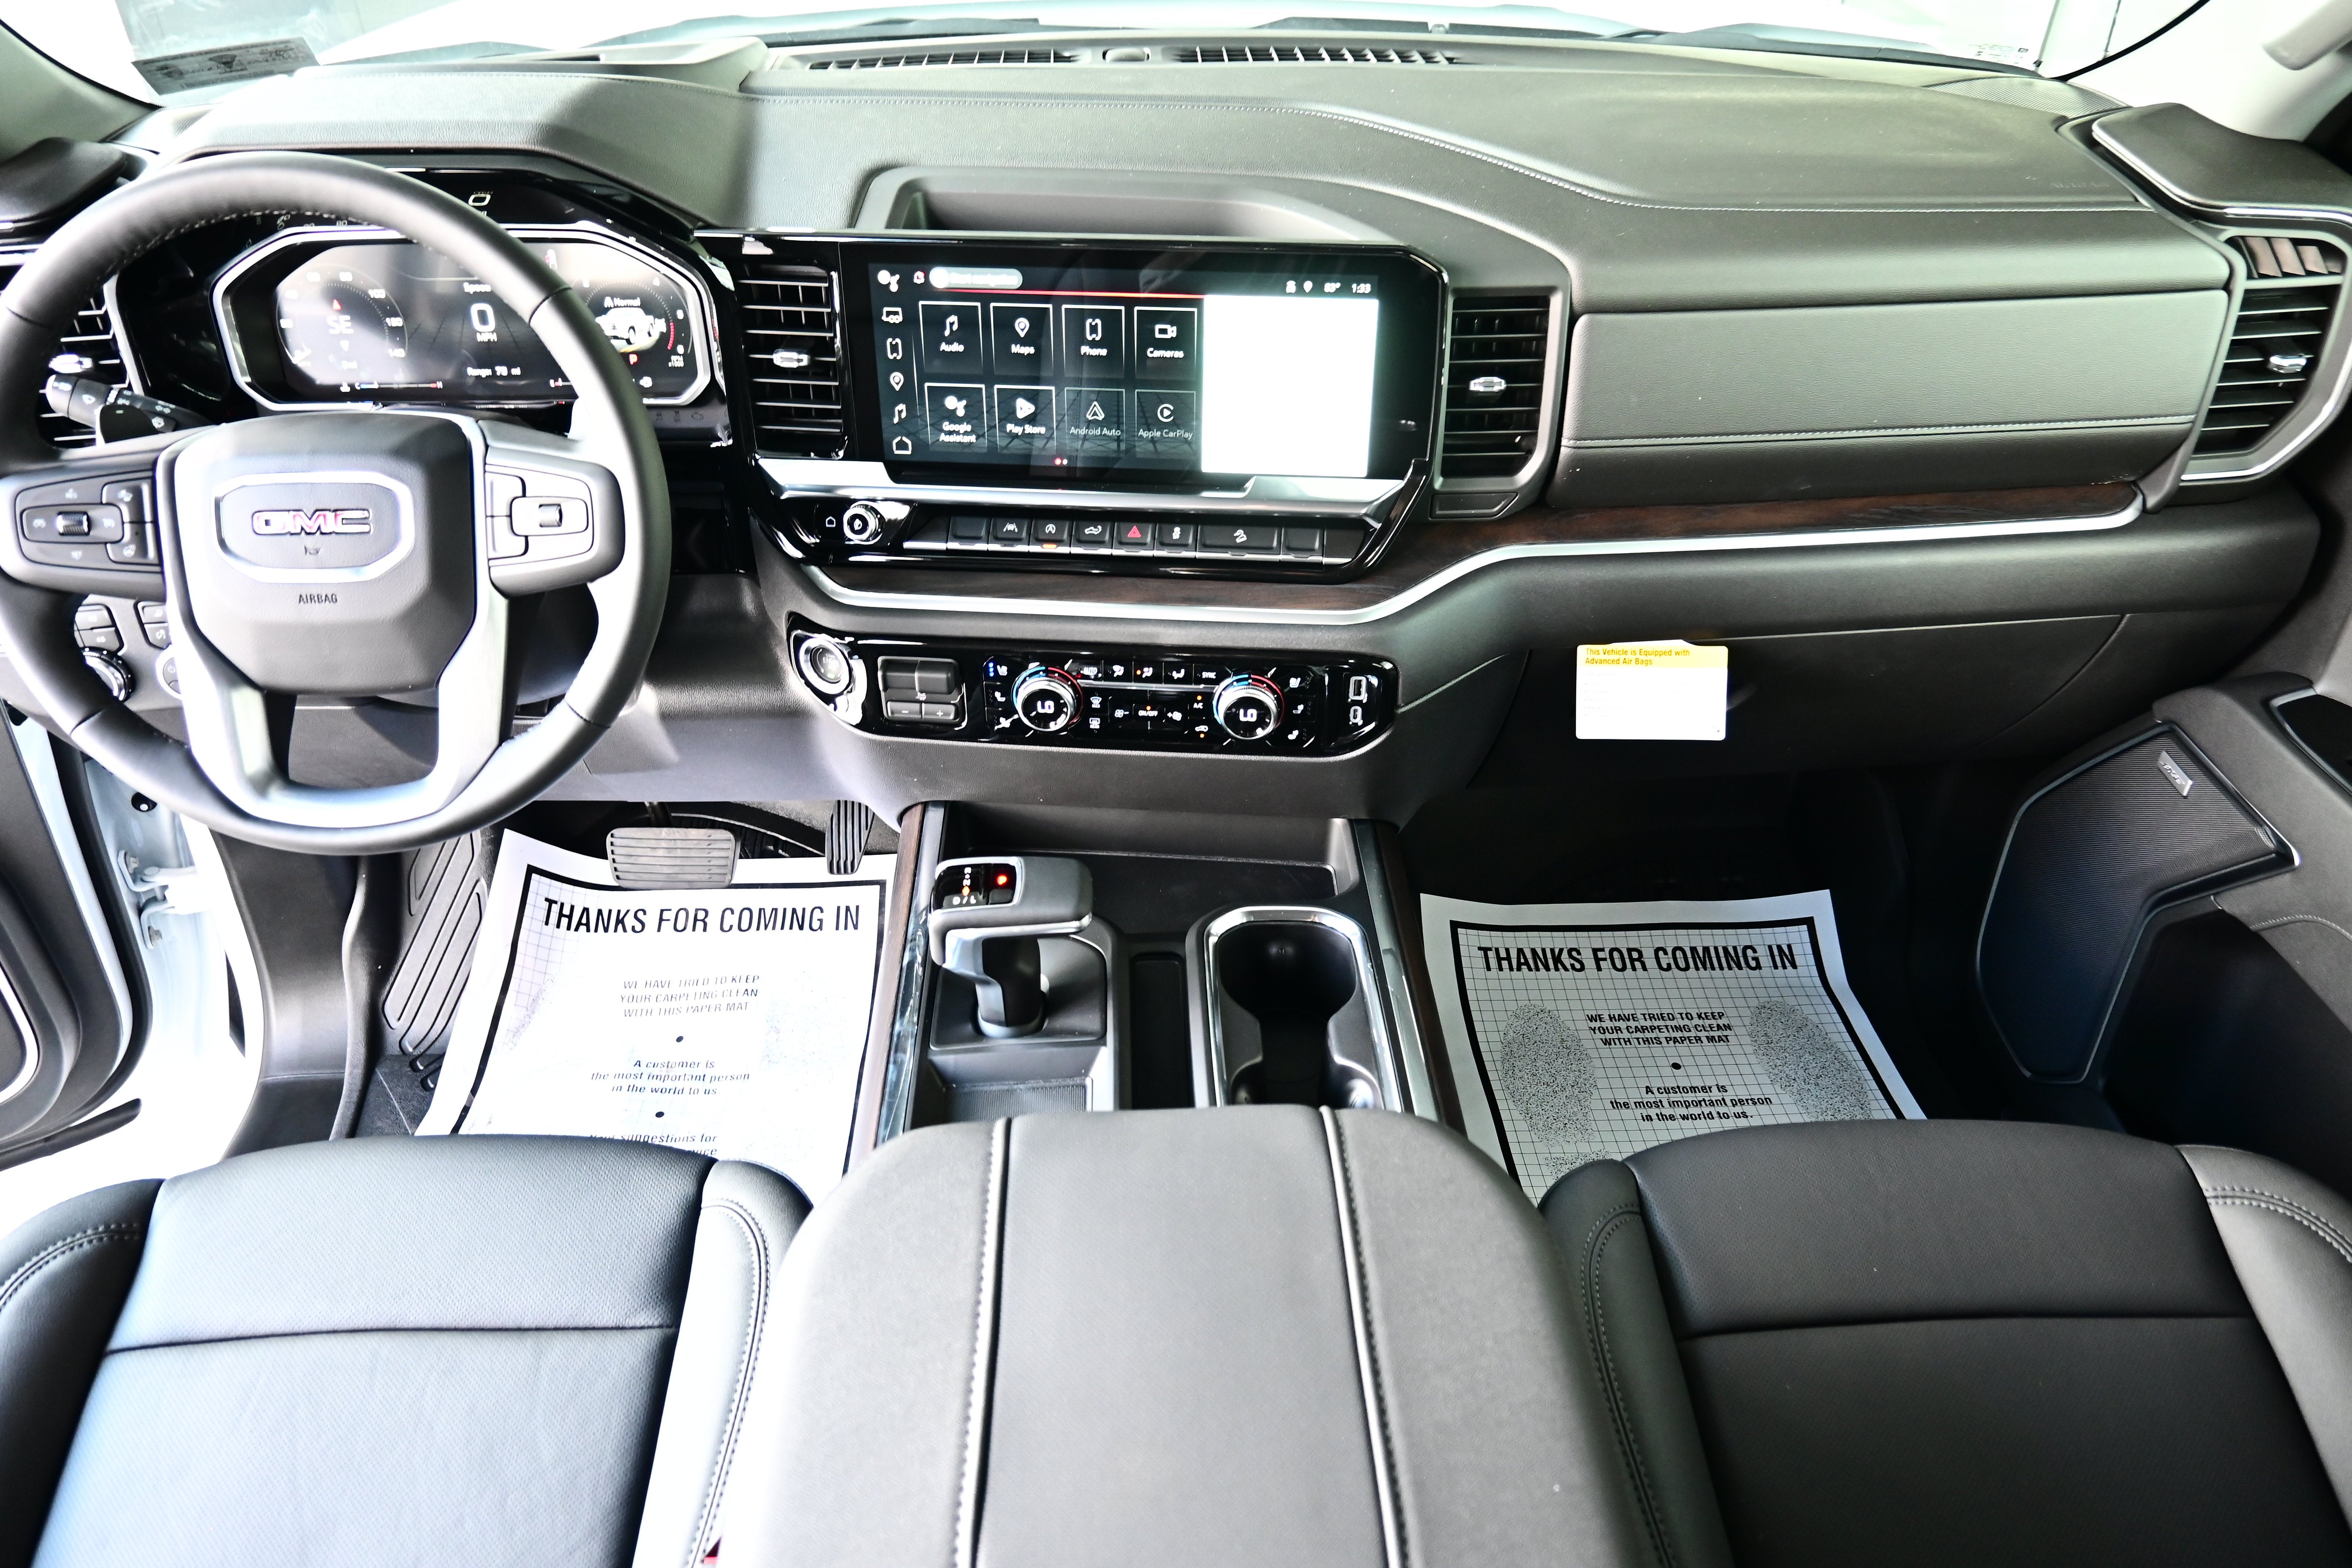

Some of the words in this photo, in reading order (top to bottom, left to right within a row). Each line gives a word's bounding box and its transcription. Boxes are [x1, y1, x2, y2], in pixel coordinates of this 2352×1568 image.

[471, 303, 495, 332] 0
[327, 316, 354, 335] SE
[476, 332, 497, 342] MPH
[940, 343, 964, 352] Audio
[1011, 344, 1035, 356] Maps
[1081, 346, 1107, 356] Phone
[1147, 348, 1184, 359] Cameras
[629, 354, 637, 365] P
[942, 422, 972, 433] Google
[1007, 424, 1023, 435] Play
[1024, 425, 1045, 435] Store
[1070, 427, 1103, 436] Android
[1104, 427, 1121, 436] Auto
[939, 433, 976, 444] Assistant
[1138, 428, 1161, 438] Apple
[1162, 430, 1193, 440] CarPlay
[252, 509, 371, 535] GMC
[299, 594, 338, 604] AIRBAG
[1639, 649, 1672, 657] Equipped
[1635, 658, 1653, 666] Bags
[544, 898, 646, 933] THANKS
[657, 907, 709, 932] FOR
[720, 906, 824, 932] COMING
[835, 905, 860, 931] IN
[1478, 947, 1585, 972] THANKS
[1592, 947, 1647, 972] FOR
[1654, 945, 1762, 972] COMING
[1768, 944, 1799, 971] IN
[645, 980, 672, 988] HAVE
[715, 976, 727, 985] TO
[732, 975, 759, 983] KEEP
[621, 994, 651, 1003] YOUR
[656, 991, 718, 1002] CARPETING
[722, 989, 758, 997] CLEAN
[624, 1008, 653, 1017] WITH
[659, 1007, 682, 1016] THIS
[686, 1004, 721, 1013] PAPER
[726, 1002, 749, 1011] MAT
[1587, 1014, 1606, 1023] WE
[1608, 1013, 1639, 1022] HAVE
[1641, 1013, 1675, 1021] TRIED
[1677, 1012, 1694, 1021] TO
[1696, 1012, 1725, 1020] KEEP
[1589, 1026, 1623, 1034] YOUR
[1626, 1024, 1692, 1034] CARPETING
[1694, 1023, 1732, 1032] CLEAN
[1600, 1037, 1632, 1046] WITH
[1633, 1037, 1663, 1045] THIS
[1664, 1036, 1704, 1045] PAPER
[1705, 1035, 1731, 1043] MAT
[646, 1060, 701, 1068] customer
[705, 1060, 714, 1068] is
[591, 1072, 609, 1080] the
[614, 1072, 643, 1080] most
[648, 1073, 706, 1083] important
[710, 1073, 750, 1083] person
[627, 1084, 645, 1094] the
[651, 1086, 684, 1095] world
[689, 1087, 699, 1095] to
[1645, 1086, 1654, 1094] A
[1657, 1085, 1712, 1094] customer
[1716, 1084, 1728, 1093] is
[1610, 1100, 1630, 1109] the
[1633, 1099, 1665, 1108] most
[1667, 1097, 1728, 1110] important
[1731, 1097, 1773, 1108] person
[1640, 1113, 1653, 1122] in
[1656, 1112, 1676, 1122] the
[1679, 1111, 1715, 1121] world
[1717, 1111, 1730, 1119] to
[1734, 1111, 1753, 1119] us.
[700, 1133, 717, 1143] for
